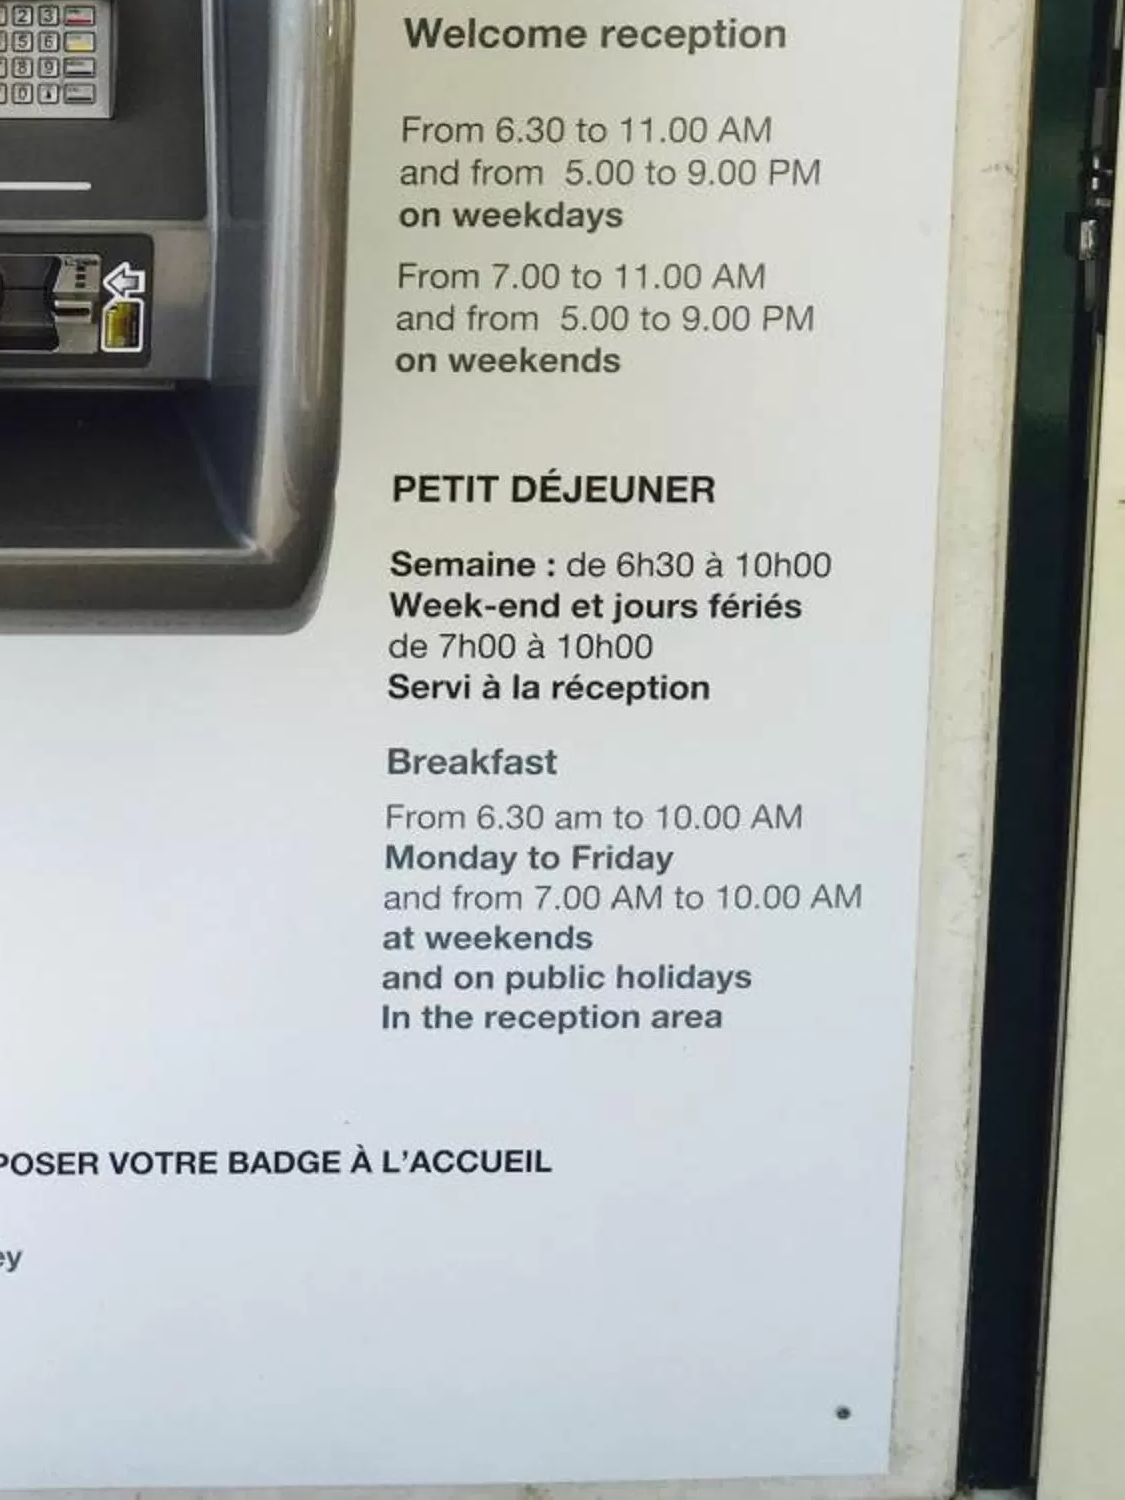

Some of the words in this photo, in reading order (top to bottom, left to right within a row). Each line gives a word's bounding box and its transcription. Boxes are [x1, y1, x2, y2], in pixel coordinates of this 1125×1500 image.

[403, 16, 588, 50] Welcome
[600, 17, 786, 56] reception
[402, 115, 485, 145] From
[495, 115, 566, 145] 6.30
[574, 117, 608, 144] to
[620, 115, 708, 145] 11.00
[716, 115, 772, 144] AM
[399, 157, 460, 187] and
[469, 157, 544, 187] from
[564, 158, 635, 187] 5.00
[644, 159, 677, 186] to
[687, 158, 757, 187] 9.00
[768, 158, 821, 187] PM
[398, 207, 441, 229] on
[451, 200, 624, 235] weekdays
[398, 261, 480, 290] From
[491, 262, 561, 291] 7.00
[570, 263, 603, 291] to
[615, 263, 702, 291] 11.00
[710, 262, 766, 291] AM
[395, 303, 456, 332] and
[465, 303, 539, 332] from
[560, 304, 630, 333] 5.00
[639, 306, 671, 333] to
[682, 304, 751, 333] 9.00
[762, 304, 814, 332] PM
[395, 352, 437, 373] on
[447, 345, 621, 374] weekends
[393, 474, 500, 503] PETIT
[510, 467, 716, 504] DÉJEUNER
[390, 549, 537, 578] Semaine
[566, 551, 607, 579] de
[616, 551, 695, 579] 6h30
[704, 551, 724, 579] à
[736, 551, 832, 579] 10h00
[389, 591, 561, 619] Week-end
[570, 593, 604, 619] et
[611, 591, 699, 625] jours
[707, 592, 802, 620] fériés
[388, 631, 428, 659] de
[438, 632, 517, 660] 7h00
[526, 631, 546, 660] à
[557, 632, 654, 661] 10h00
[387, 672, 471, 701] Servi
[481, 673, 501, 701] à
[512, 673, 540, 701] la
[551, 673, 710, 707] réception
[387, 747, 558, 776] Breakfast
[386, 803, 466, 831] From
[476, 803, 545, 831] 6.30
[554, 809, 603, 831] am
[612, 805, 645, 831] to
[656, 803, 742, 832] 10.00
[749, 803, 803, 830] AM
[385, 843, 519, 877] Monday
[526, 845, 561, 871] to
[572, 843, 675, 877] Friday
[383, 884, 442, 912] and
[451, 883, 523, 911] from
[534, 884, 602, 911] 7.00
[610, 883, 663, 911] AM
[673, 885, 705, 911] to
[716, 883, 801, 911] 10.00
[810, 883, 862, 910] AM
[382, 925, 416, 951] at
[424, 924, 594, 951] weekends
[382, 964, 443, 991] and
[453, 970, 495, 991] on
[505, 963, 606, 996] public
[616, 963, 752, 995] holidays
[382, 1004, 411, 1030] In
[420, 1003, 474, 1030] the
[484, 1003, 641, 1035] reception
[650, 1009, 723, 1029] area
[108, 1150, 218, 1176] VOTRE
[228, 1149, 342, 1175] BADGE
[349, 1143, 373, 1174] À
